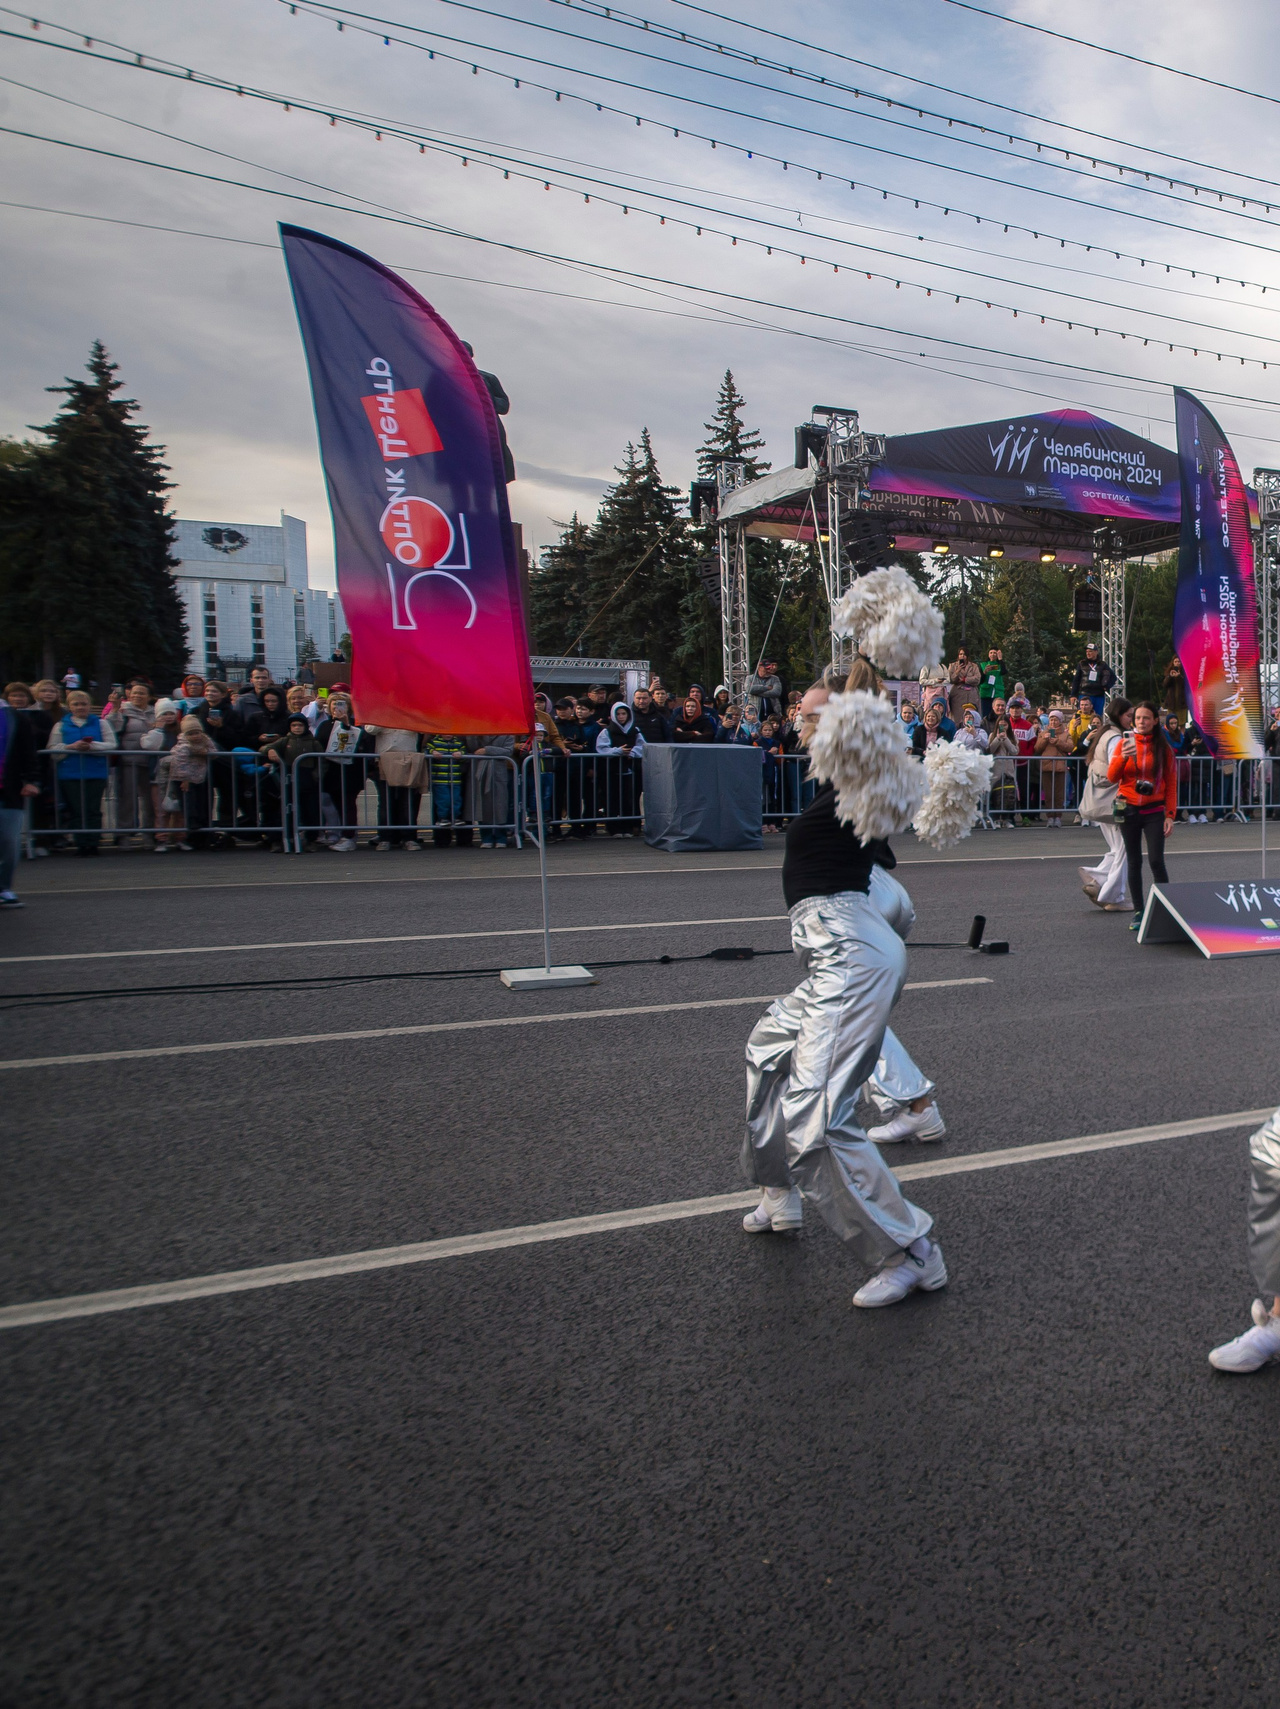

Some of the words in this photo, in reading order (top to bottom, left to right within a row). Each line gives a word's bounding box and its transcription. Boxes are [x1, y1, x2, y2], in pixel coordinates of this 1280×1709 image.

[1043, 436, 1145, 466] Челябинский
[1043, 456, 1122, 482] Марафон
[1127, 465, 1162, 486] 2024
[1082, 490, 1131, 503] ЭСТЕТИКА
